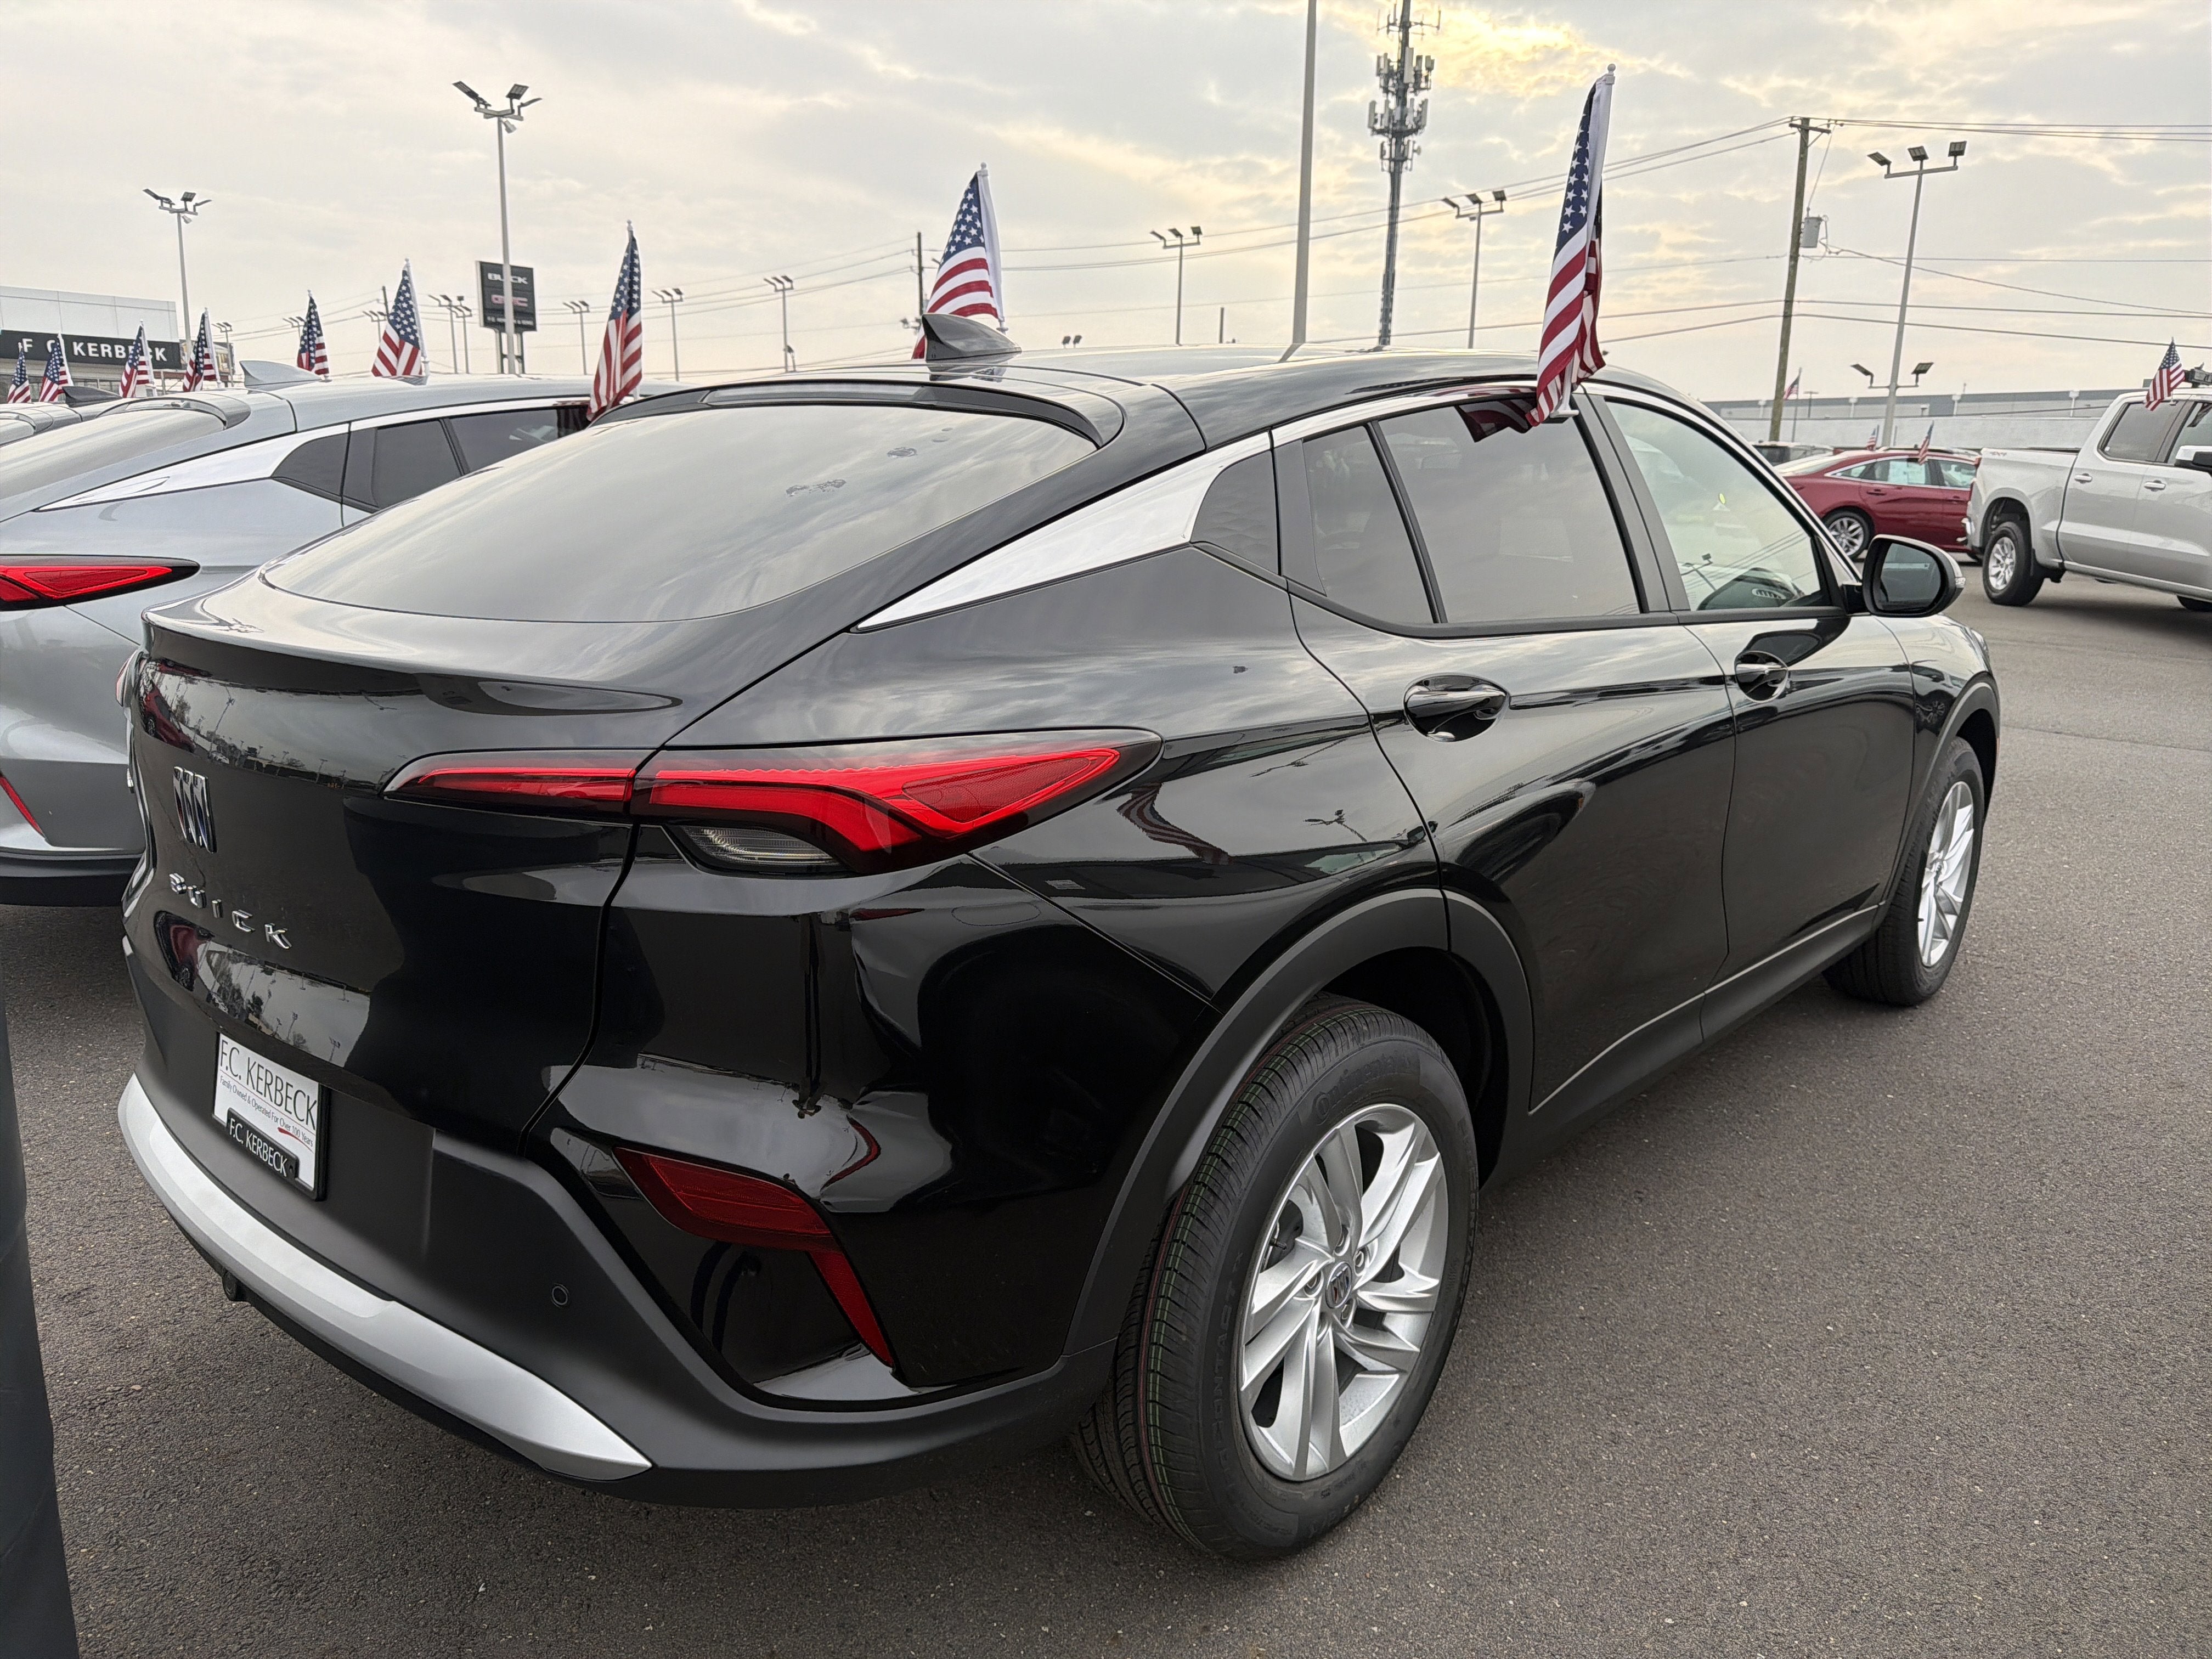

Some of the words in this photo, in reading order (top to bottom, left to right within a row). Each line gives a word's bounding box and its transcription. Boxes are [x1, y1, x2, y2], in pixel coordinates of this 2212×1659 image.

[487, 273, 528, 284] BUCK
[72, 341, 167, 361] KERBK
[169, 873, 292, 949] BUICK
[219, 1075, 232, 1092] Family
[233, 1085, 247, 1102] Owned
[252, 1098, 271, 1119] Operated
[280, 1118, 291, 1132] Over
[292, 1125, 301, 1138] 100
[301, 1131, 313, 1147] Years
[220, 1039, 241, 1080] F.C.
[246, 1057, 317, 1131] KERBECK
[229, 1118, 244, 1144] F.C.
[246, 1130, 287, 1177] KERBECK
